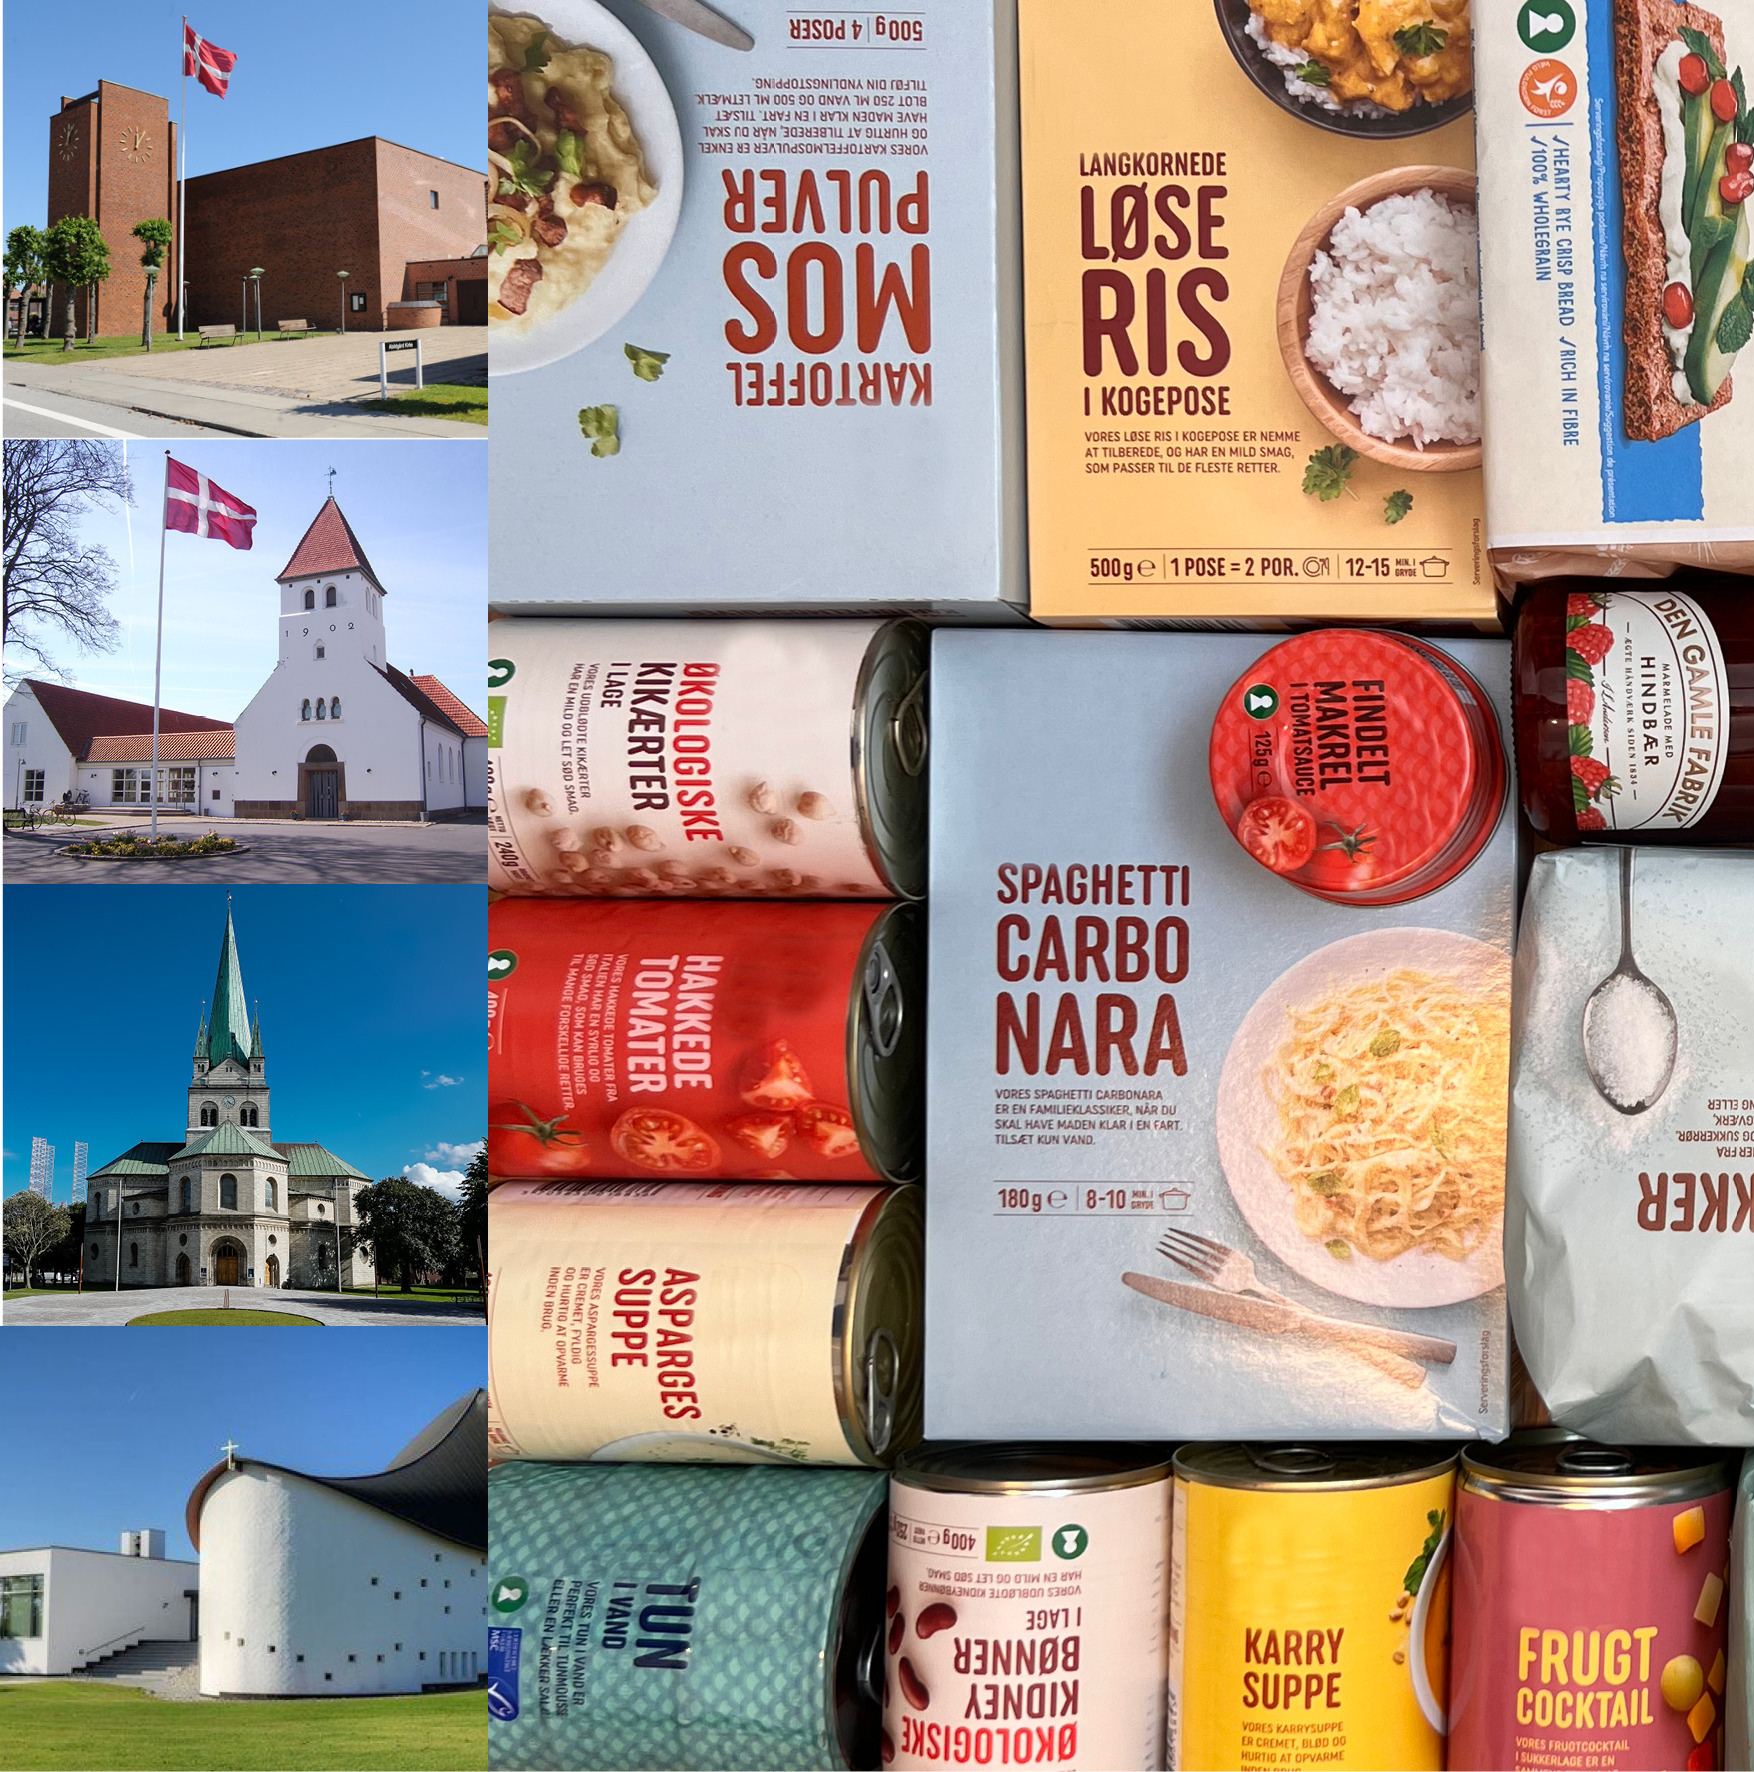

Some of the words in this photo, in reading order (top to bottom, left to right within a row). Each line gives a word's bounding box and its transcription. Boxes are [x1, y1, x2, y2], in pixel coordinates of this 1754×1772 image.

[790, 19, 845, 40] POSER
[852, 20, 862, 40] 4
[876, 16, 922, 41] 500g
[1080, 152, 1226, 176] LANGKORNEDE
[1532, 149, 1548, 184] 100%
[1554, 149, 1570, 200] HEARTY
[722, 169, 929, 234] PULVER
[1081, 182, 1229, 263] LØSE
[1556, 208, 1571, 232] RYE
[1534, 192, 1551, 280] WHOLEGRAIN
[1557, 239, 1573, 275] CRISP
[723, 241, 931, 354] MOS
[1558, 283, 1574, 326] BREAD
[1082, 267, 1230, 377] RIS
[726, 362, 931, 406] KARTOFFEL
[1560, 350, 1576, 381] RICH
[1102, 386, 1231, 416] KOGEPOSE
[1562, 388, 1577, 402] IN
[1563, 410, 1579, 446] FIBRE
[1091, 558, 1133, 581] 500g
[1171, 558, 1179, 576] 1
[1185, 558, 1225, 576] POSE
[1231, 563, 1240, 571] =
[1245, 557, 1254, 576] 2
[1261, 558, 1298, 576] POR.
[1346, 558, 1389, 576] 12-15
[1395, 569, 1417, 577] GRYDE
[1472, 518, 1481, 586] Serveringsforslag
[1654, 599, 1698, 641] DEN
[601, 672, 628, 708] LAGE
[1625, 667, 1635, 723] HÅNDVÆRK
[1641, 657, 1659, 765] HINDBÆR
[1662, 663, 1672, 731] MARMELADE
[1683, 645, 1713, 740] GAMLE
[628, 663, 677, 810] KIKÆRTER
[673, 663, 724, 841] ØKOLOGISKE
[1254, 730, 1272, 766] 125g
[1290, 693, 1315, 796] TOMATSAUCE
[1314, 681, 1352, 790] MAKREL
[1352, 680, 1390, 786] FINDELT
[1628, 729, 1636, 759] SIDEN
[1665, 736, 1673, 758] MED
[1629, 764, 1638, 785] 1834
[1662, 747, 1711, 822] FABRIK
[495, 841, 519, 866] 240g
[998, 863, 1189, 906] SPAGHETTI
[997, 914, 1189, 983] CARBO
[627, 955, 679, 1092] TOMATER
[673, 956, 723, 1088] HAKKEDE
[996, 992, 1187, 1076] NARA
[1708, 1099, 1738, 1110] ELLER
[1676, 1131, 1739, 1142] SUKKERRØR.
[1717, 1147, 1736, 1157] FRA
[998, 1189, 1041, 1212] 180g
[1087, 1190, 1125, 1209] 8-10
[611, 1269, 656, 1367] SUPPE
[656, 1269, 701, 1419] ASPARGES
[943, 1528, 976, 1551] 400g
[602, 1597, 634, 1649] VAND
[634, 1577, 700, 1669] TUN
[1026, 1608, 1069, 1630] LAGE
[954, 1636, 1080, 1676] BØNNER
[1245, 1628, 1344, 1665] KARRY
[1519, 1627, 1657, 1686] FRUGT
[965, 1680, 1078, 1720] KIDNEY
[1243, 1672, 1341, 1709] SUPPE
[1517, 1688, 1653, 1728] COCKTAIL
[901, 1716, 1077, 1764] ØKOLOGISKE
